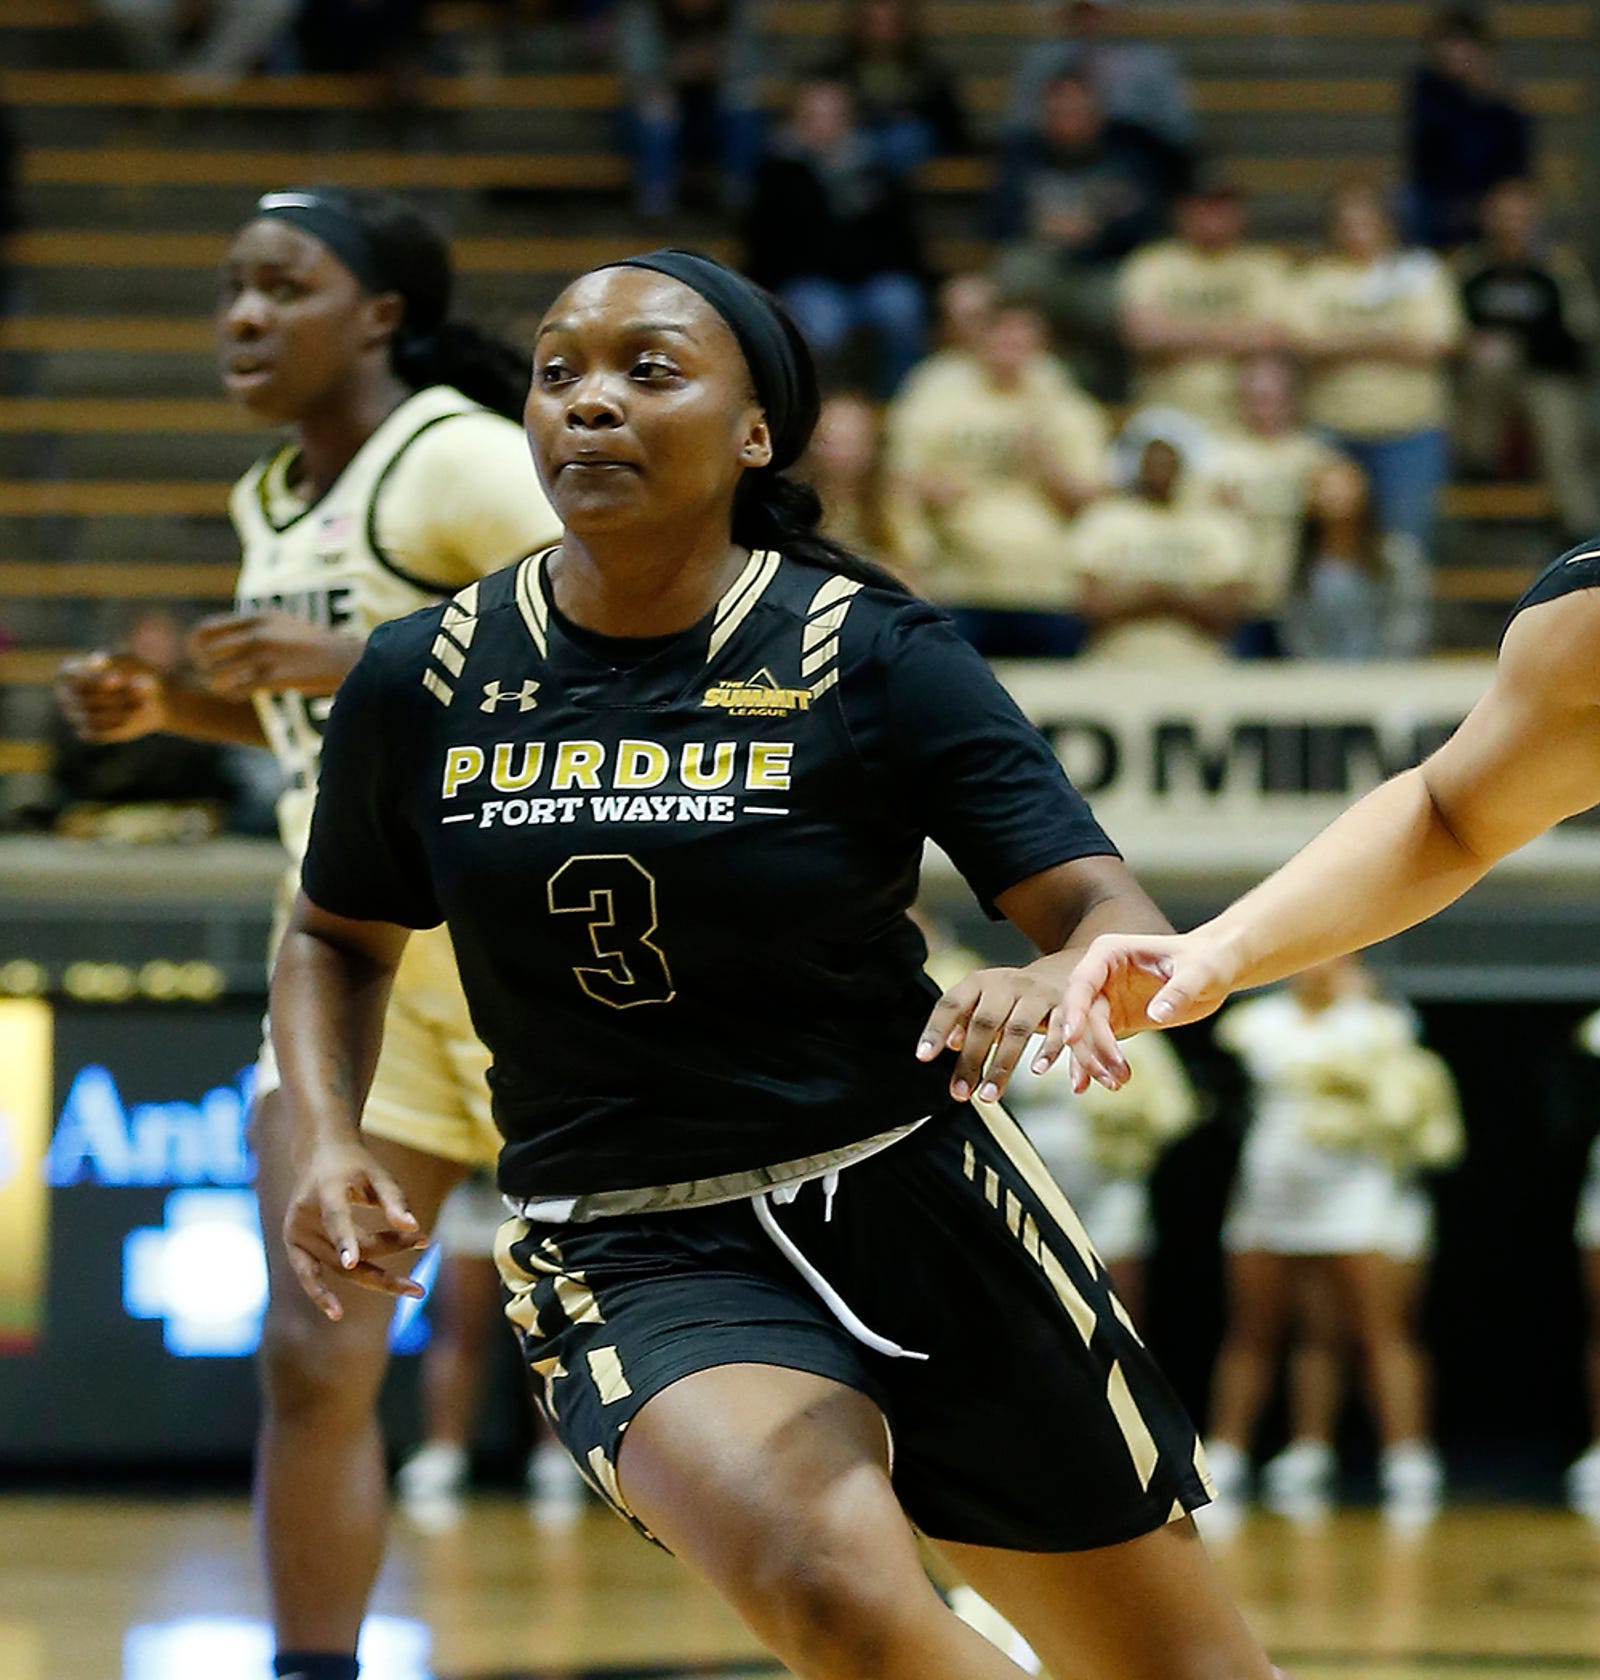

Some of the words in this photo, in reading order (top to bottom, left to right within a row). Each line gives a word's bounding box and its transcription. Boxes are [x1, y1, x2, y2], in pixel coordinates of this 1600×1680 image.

[700, 687, 813, 711] SUMMIT
[718, 680, 745, 690] THE
[728, 707, 788, 718] LEAGUE
[441, 739, 795, 800] PURDUE
[479, 797, 584, 828] FORT
[590, 795, 735, 824] WAYNE
[546, 853, 677, 1010] 3
